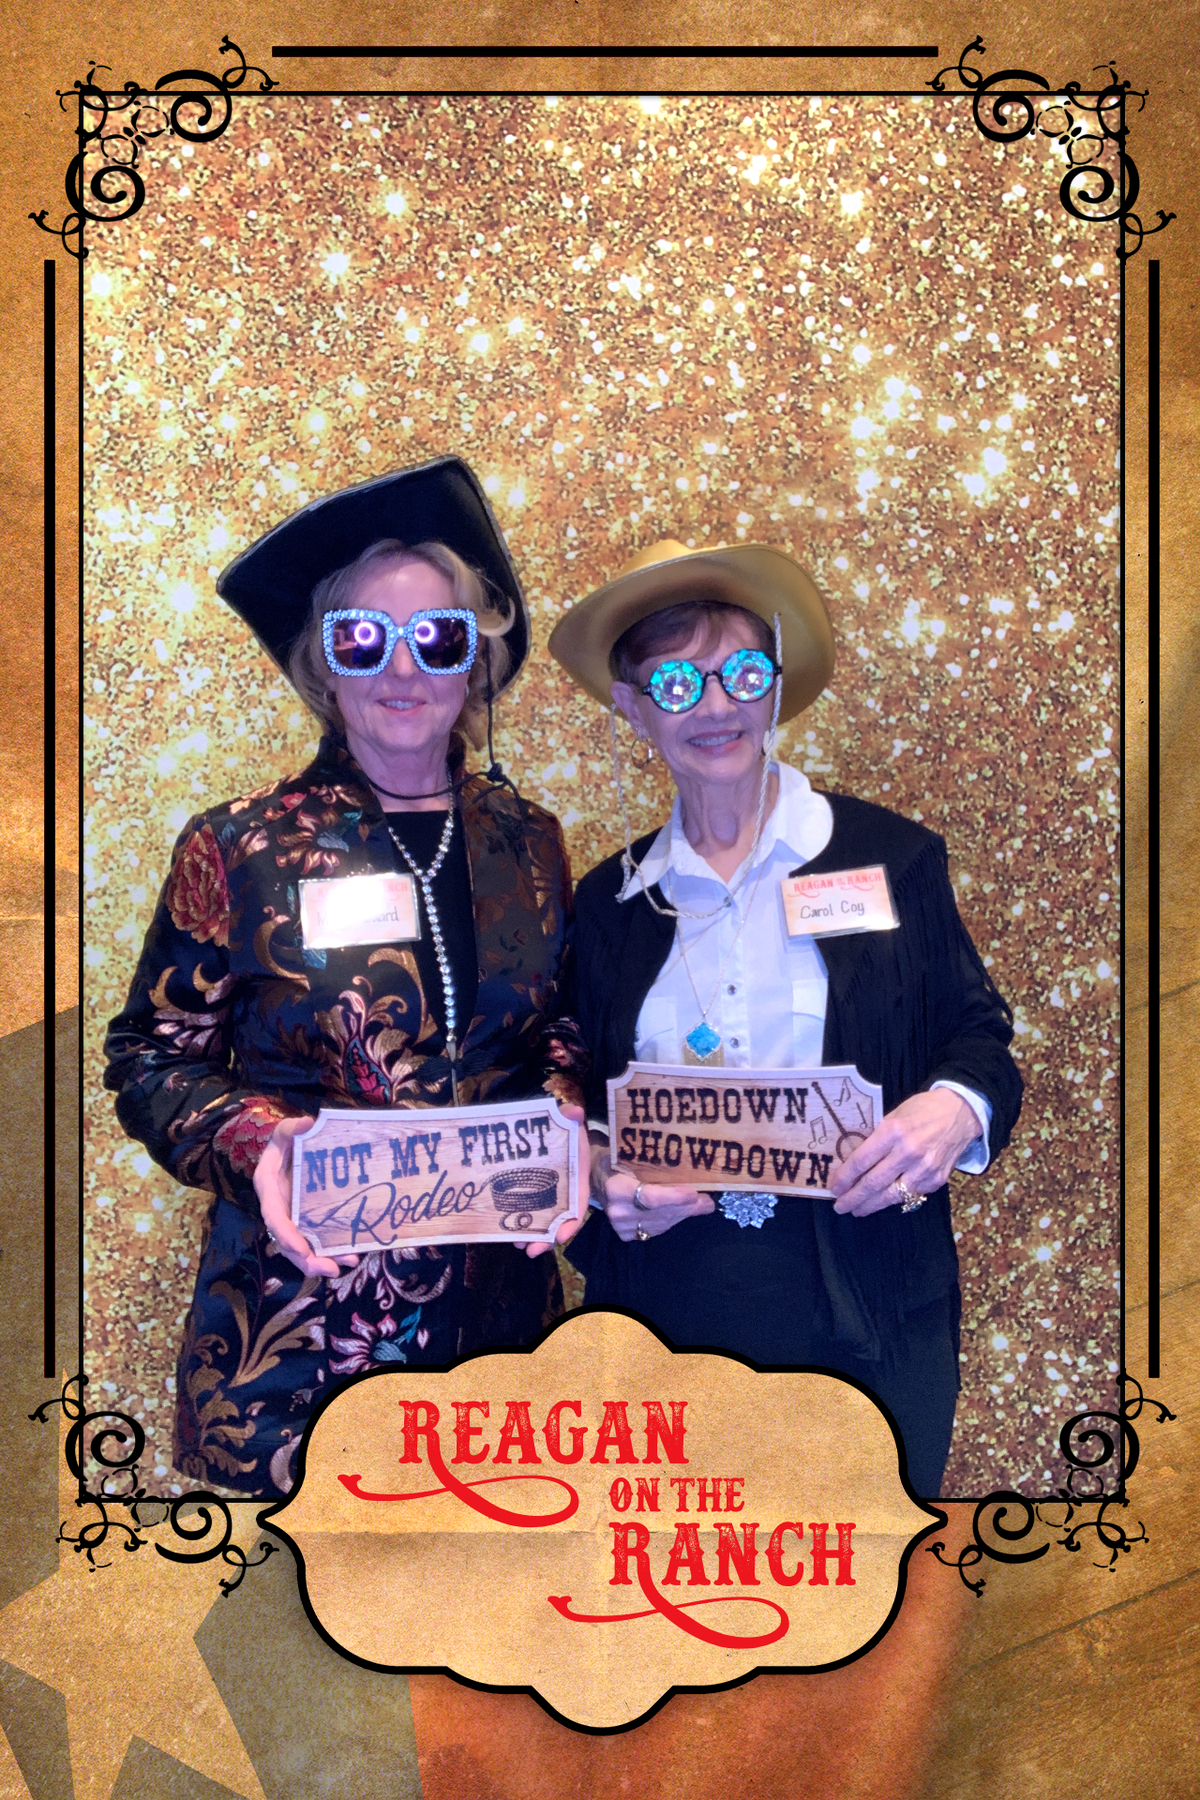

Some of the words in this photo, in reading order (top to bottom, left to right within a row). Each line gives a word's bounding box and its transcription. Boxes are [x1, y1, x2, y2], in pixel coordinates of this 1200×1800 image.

[794, 878, 834, 893] REAGAN
[847, 872, 882, 886] RANCH
[800, 903, 834, 919] Carol
[840, 900, 865, 916] Coy
[626, 1087, 809, 1124] HOEDOWN
[303, 1143, 371, 1193] NOT
[388, 1131, 441, 1179] MY
[458, 1116, 551, 1167] FIRST
[617, 1127, 834, 1189] SHOWDOWN
[301, 1170, 484, 1247] Rodeo
